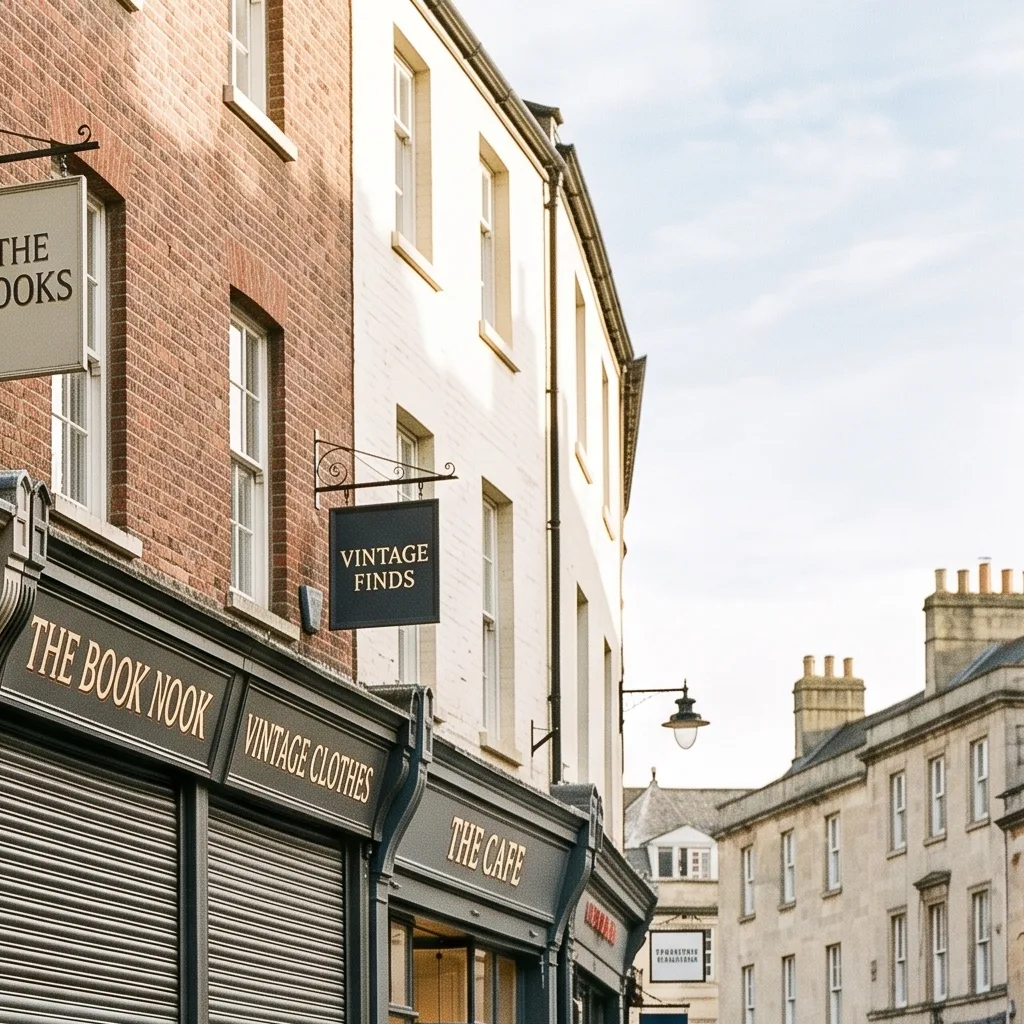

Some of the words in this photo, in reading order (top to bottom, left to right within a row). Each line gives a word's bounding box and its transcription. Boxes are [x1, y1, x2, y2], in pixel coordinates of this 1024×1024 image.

[339, 543, 429, 568] VINTAGE
[354, 569, 415, 592] FINDS
[26, 614, 81, 687] THE
[78, 639, 150, 715] BOOK
[147, 670, 214, 740] NOOK
[244, 713, 311, 778] VINTAGE
[309, 744, 374, 804] CLOTHES
[447, 816, 485, 870] THE
[482, 834, 527, 887] CAFE
